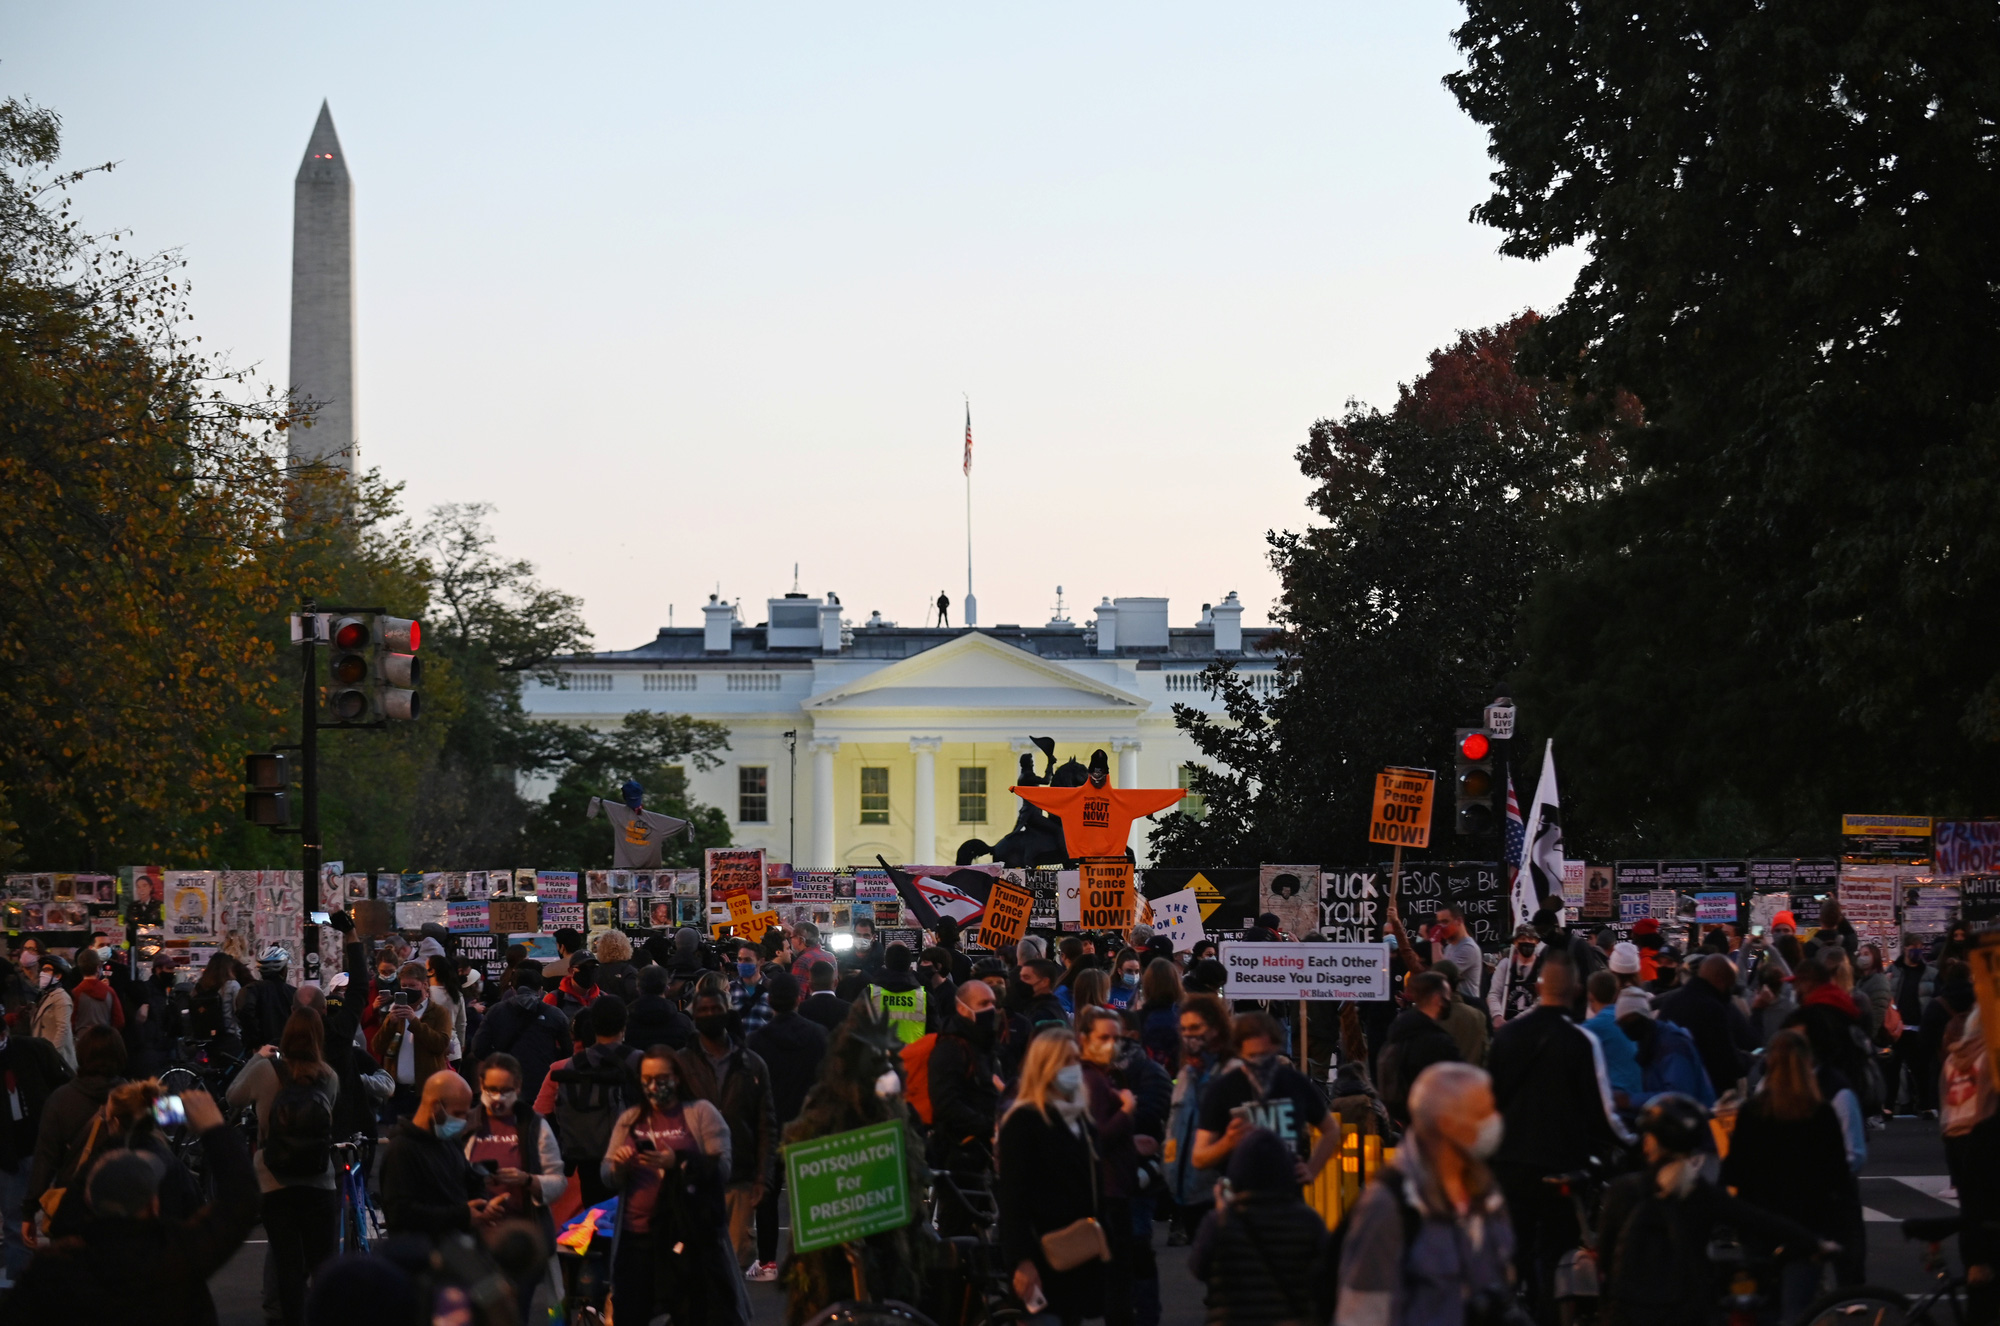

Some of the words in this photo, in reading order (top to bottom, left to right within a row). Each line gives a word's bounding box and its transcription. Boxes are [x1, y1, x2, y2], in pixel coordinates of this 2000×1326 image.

[1382, 776, 1428, 793] Trump/
[1384, 789, 1424, 804] Pence
[1084, 802, 1110, 812] #OUT
[1384, 804, 1420, 824] OUT
[1083, 811, 1109, 822] NOW!
[1373, 822, 1424, 844] NOW!
[1084, 865, 1128, 878] Trump/
[176, 878, 206, 887] JUSTICE
[1088, 878, 1126, 888] Pence
[1320, 872, 1379, 899] FUCK
[1382, 871, 1441, 898] JESUS
[994, 886, 1030, 907] Trump/
[1035, 890, 1044, 898] IS
[1090, 890, 1124, 908] OUT
[500, 903, 527, 912] BLACK
[993, 898, 1024, 918] Pence
[1166, 904, 1188, 914] THE
[1320, 901, 1378, 926] YOUR
[1456, 900, 1498, 914] MORE
[1620, 903, 1650, 914] LIES
[180, 916, 203, 924] QUEEN
[500, 912, 526, 920] LIVES
[1083, 909, 1130, 926] NOW!
[174, 925, 208, 934] BREONNA
[496, 922, 529, 930] MATTER
[732, 916, 775, 936] ESUS
[990, 912, 1020, 935] OUT
[1320, 926, 1375, 943] FENCE
[1618, 931, 1628, 939] IS
[460, 936, 494, 948] TRUMP
[456, 948, 466, 956] IS
[468, 948, 497, 960] UNFIT
[1230, 955, 1258, 968] Stop
[1262, 956, 1304, 970] Hating
[1308, 956, 1337, 968] Each
[1342, 956, 1378, 968] Other
[1236, 972, 1286, 983] Because
[1289, 972, 1312, 983] You
[1316, 973, 1372, 986] Disagree
[1300, 989, 1376, 998] DCBlackTours.com
[882, 996, 914, 1006] PRESS
[800, 1142, 896, 1179] POTSQUATCH
[836, 1175, 862, 1194] For
[810, 1186, 896, 1222] PRESIDENT
